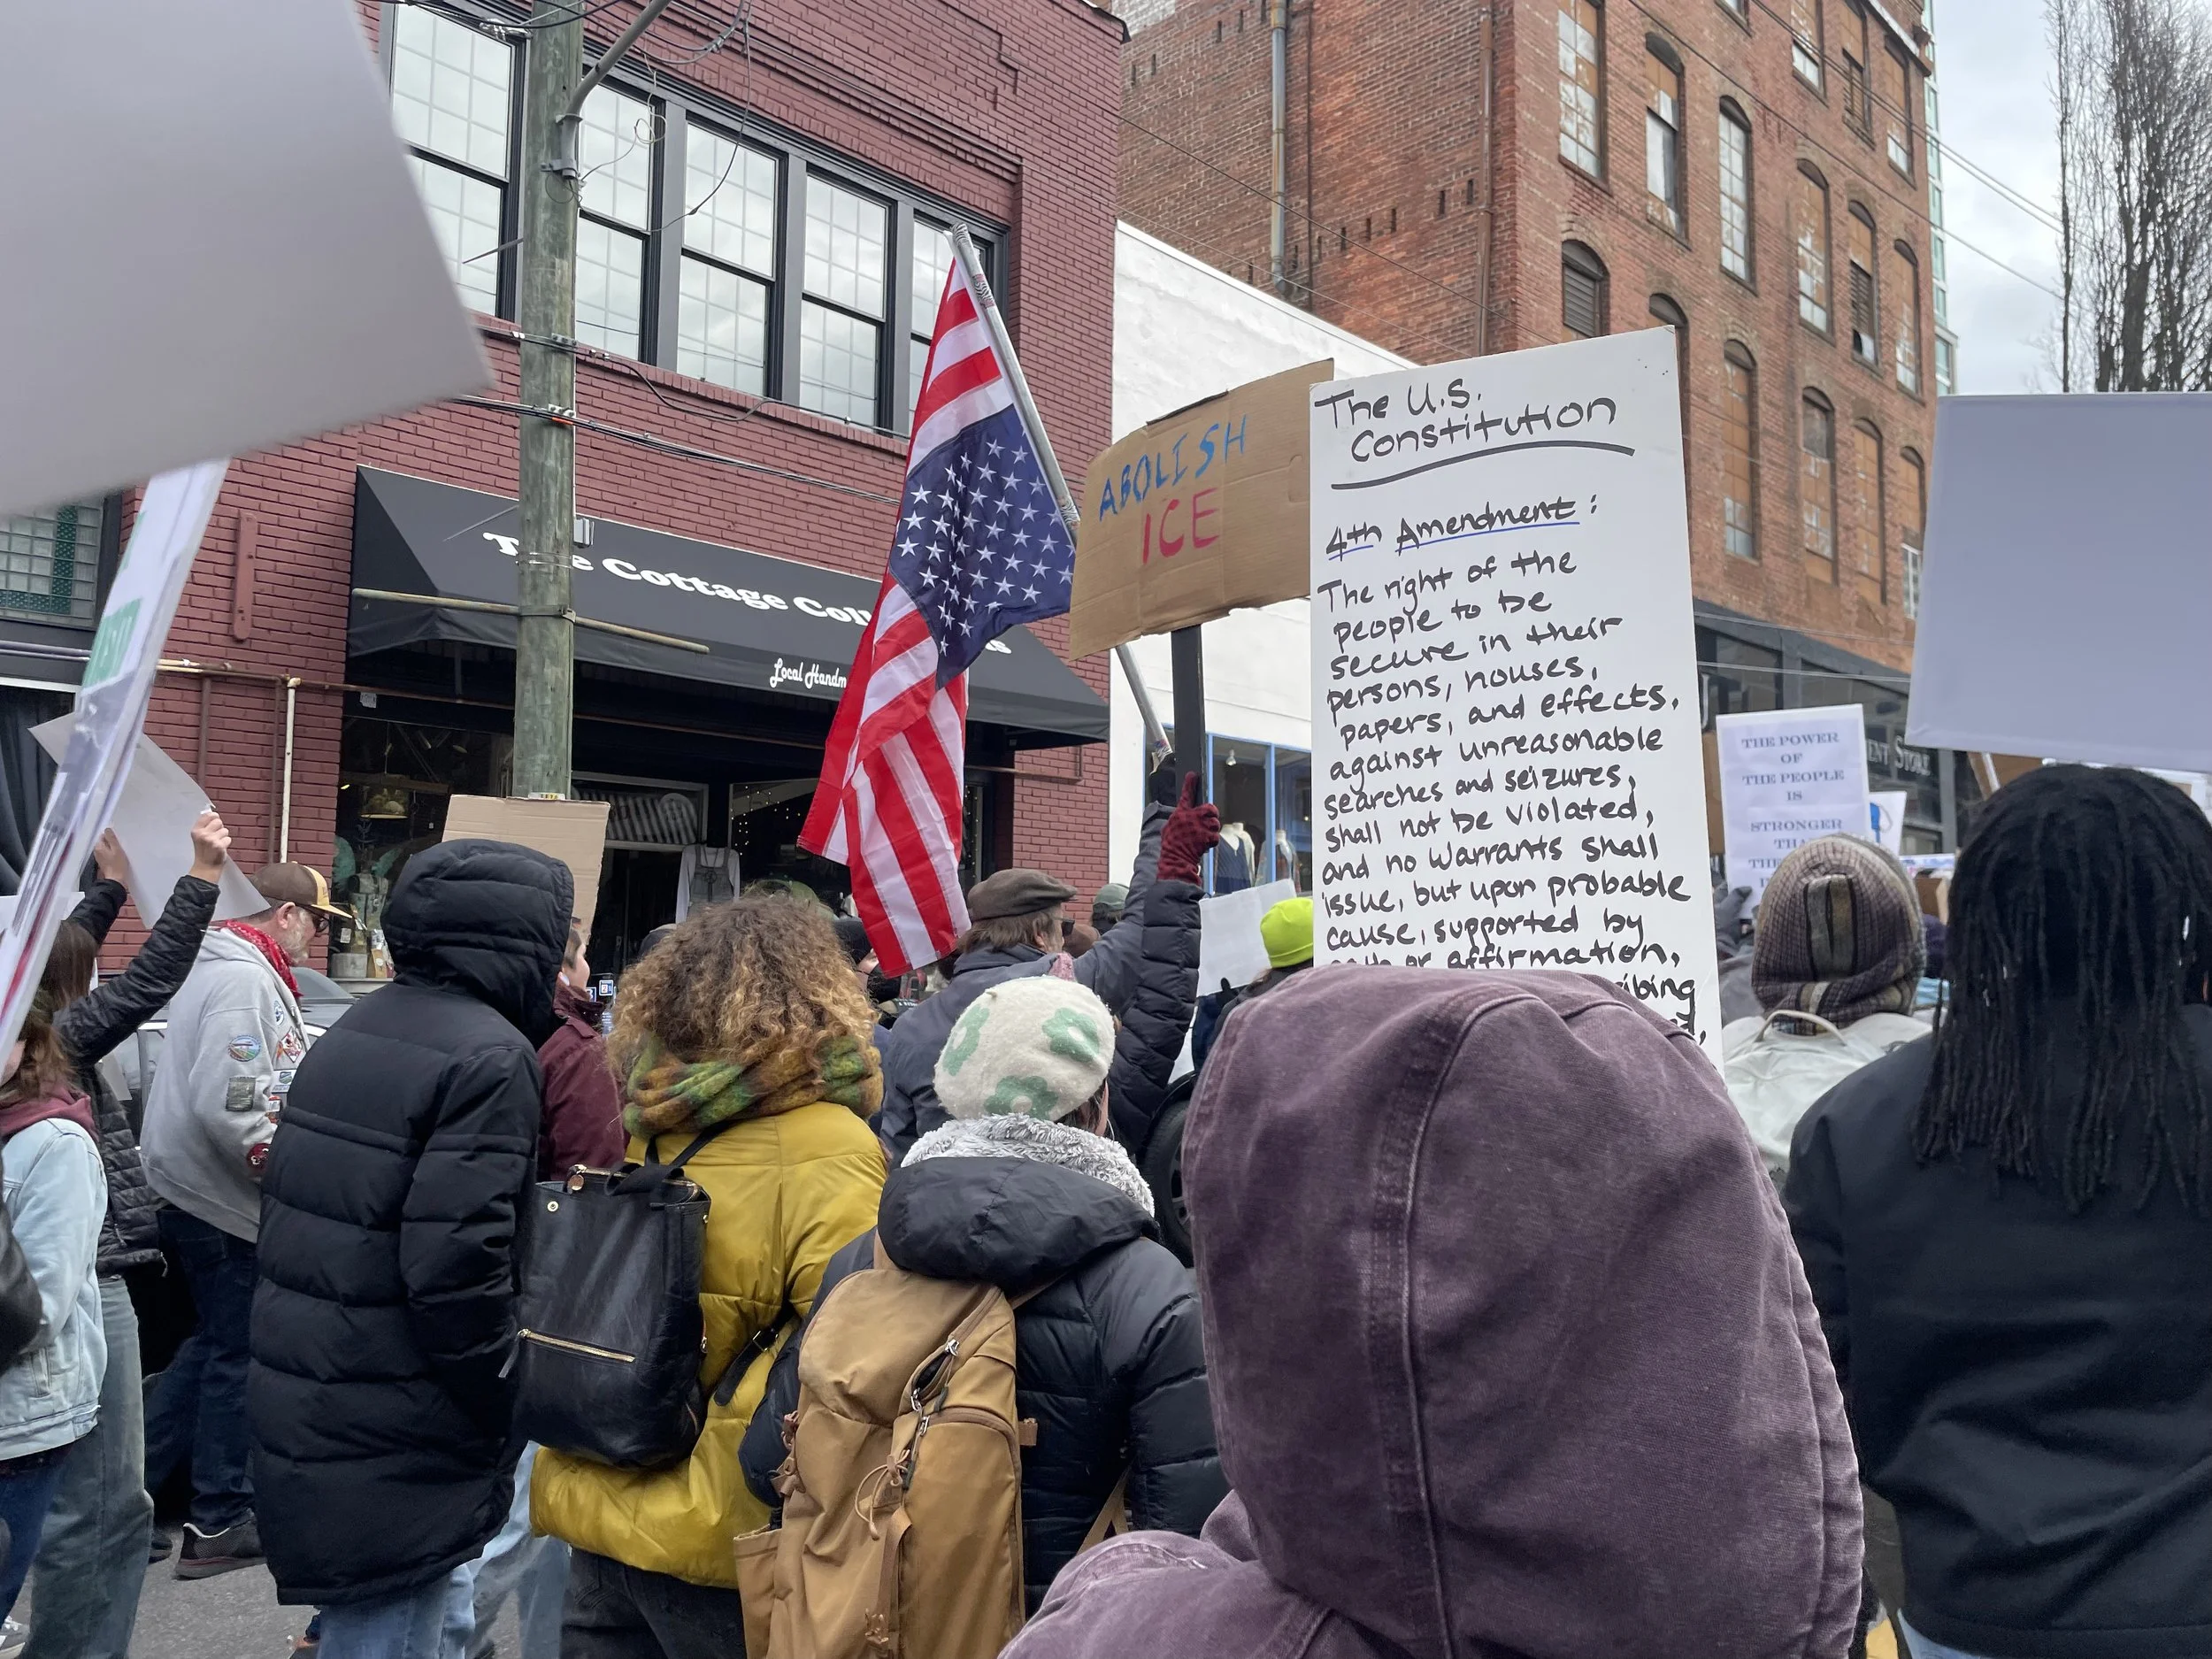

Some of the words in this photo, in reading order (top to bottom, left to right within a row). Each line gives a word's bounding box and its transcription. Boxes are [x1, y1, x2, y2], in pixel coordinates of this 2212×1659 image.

[1315, 389, 1389, 428] The
[1408, 378, 1482, 416] U.S.
[1351, 396, 1617, 462] Constitution
[1099, 414, 1248, 521] ABOLISH
[1142, 488, 1219, 565] ICE
[1326, 524, 1382, 561] 4th
[482, 533, 594, 571] Te
[603, 558, 788, 610] Cottage
[1317, 580, 1374, 612] The
[1384, 567, 1453, 613] right
[1468, 556, 1497, 583] of
[1510, 549, 1578, 577] the
[1333, 609, 1443, 654] people
[1450, 598, 1481, 620] to
[1498, 589, 1552, 614] be
[770, 657, 803, 687] Local
[1330, 641, 1469, 680] secure
[1479, 633, 1511, 654] in
[1526, 617, 1624, 646] their
[1327, 674, 1452, 726] persons,
[1340, 711, 1452, 751] papers,
[1468, 694, 1525, 726] and
[1540, 682, 1679, 718] effects,
[1330, 745, 1443, 793] against
[1459, 726, 1663, 762] unreasonable
[1741, 738, 1775, 749] THE
[1780, 733, 1839, 746] POWER
[1780, 754, 1802, 764] OF
[1324, 781, 1444, 820] searches
[1455, 769, 1494, 795] and
[1504, 762, 1636, 792] seizures,
[1742, 774, 1776, 786] THE
[1780, 770, 1844, 783] PEOPLE
[1787, 791, 1802, 801] IS
[1325, 820, 1382, 853] shall
[1401, 811, 1441, 837] not
[1451, 807, 1493, 834] be
[1505, 795, 1654, 829] violated,
[1750, 819, 1842, 832] STRONGER
[1322, 854, 1370, 885] and
[1386, 854, 1417, 873] no
[1581, 832, 1659, 863] shall
[1322, 889, 1404, 918] issue,
[1415, 879, 1463, 905] but
[1470, 879, 1536, 908] upon
[1548, 870, 1692, 908] probable
[1327, 920, 1426, 951] cause,
[1434, 905, 1578, 944] supported
[1603, 908, 1644, 950] by
[1448, 938, 1680, 970] affirmation,
